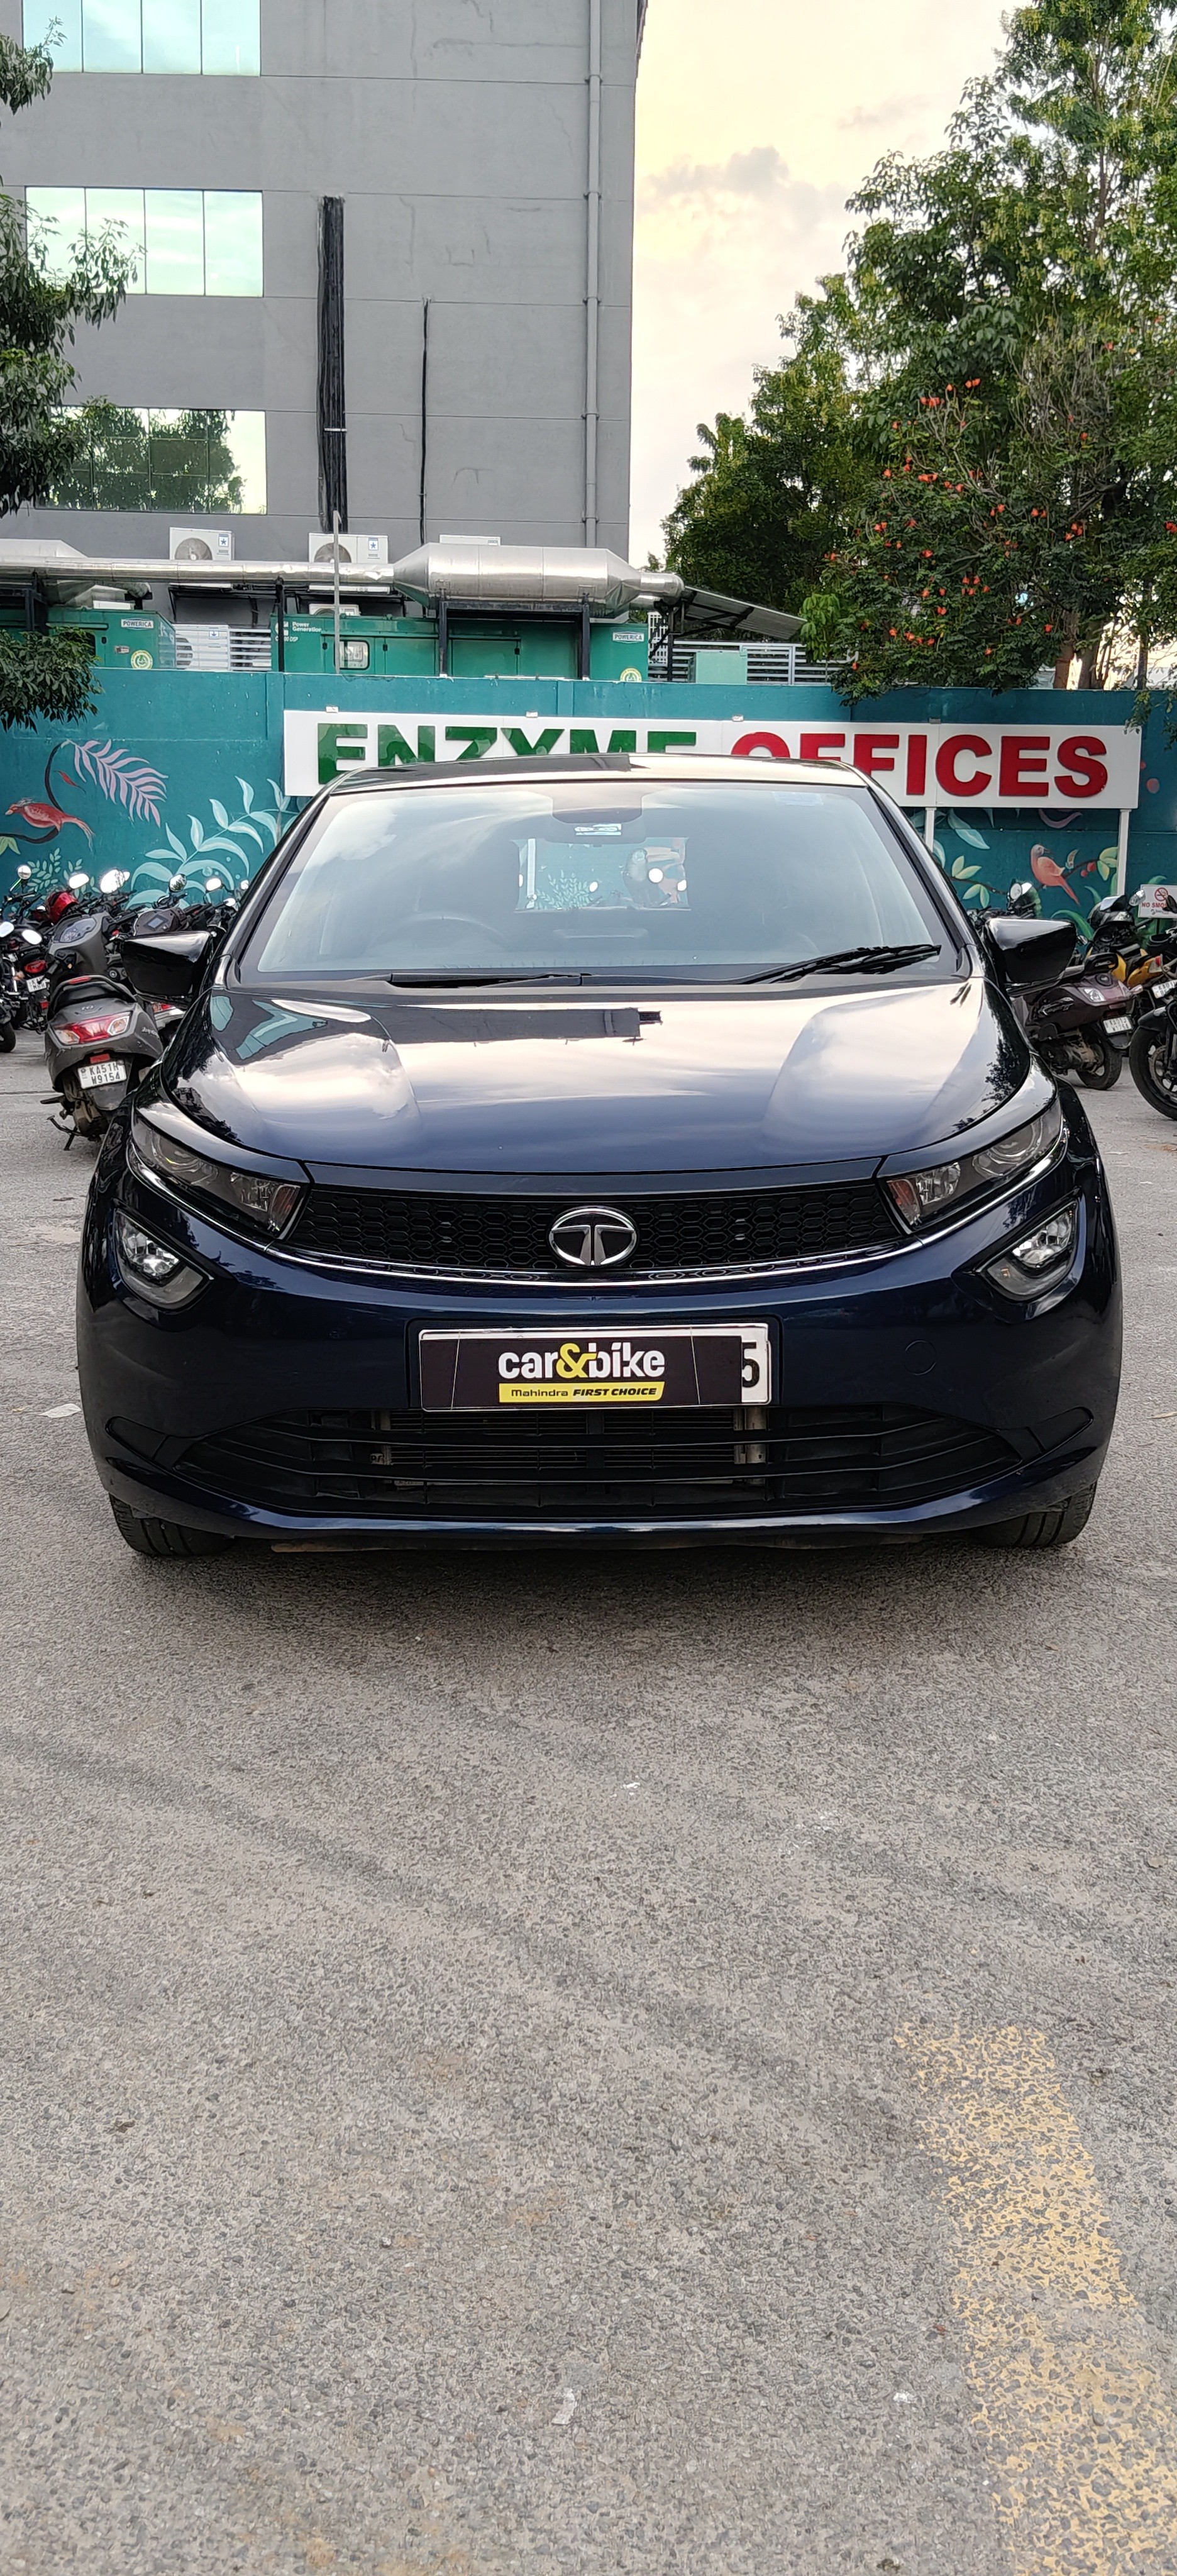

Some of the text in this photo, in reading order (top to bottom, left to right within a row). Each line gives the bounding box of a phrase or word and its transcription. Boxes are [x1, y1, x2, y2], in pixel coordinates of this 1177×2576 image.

[91, 1071, 121, 1085] W9154
[498, 1342, 665, 1379] car&bike
[511, 1387, 657, 1397] Mahindra FIRST CHOICE
